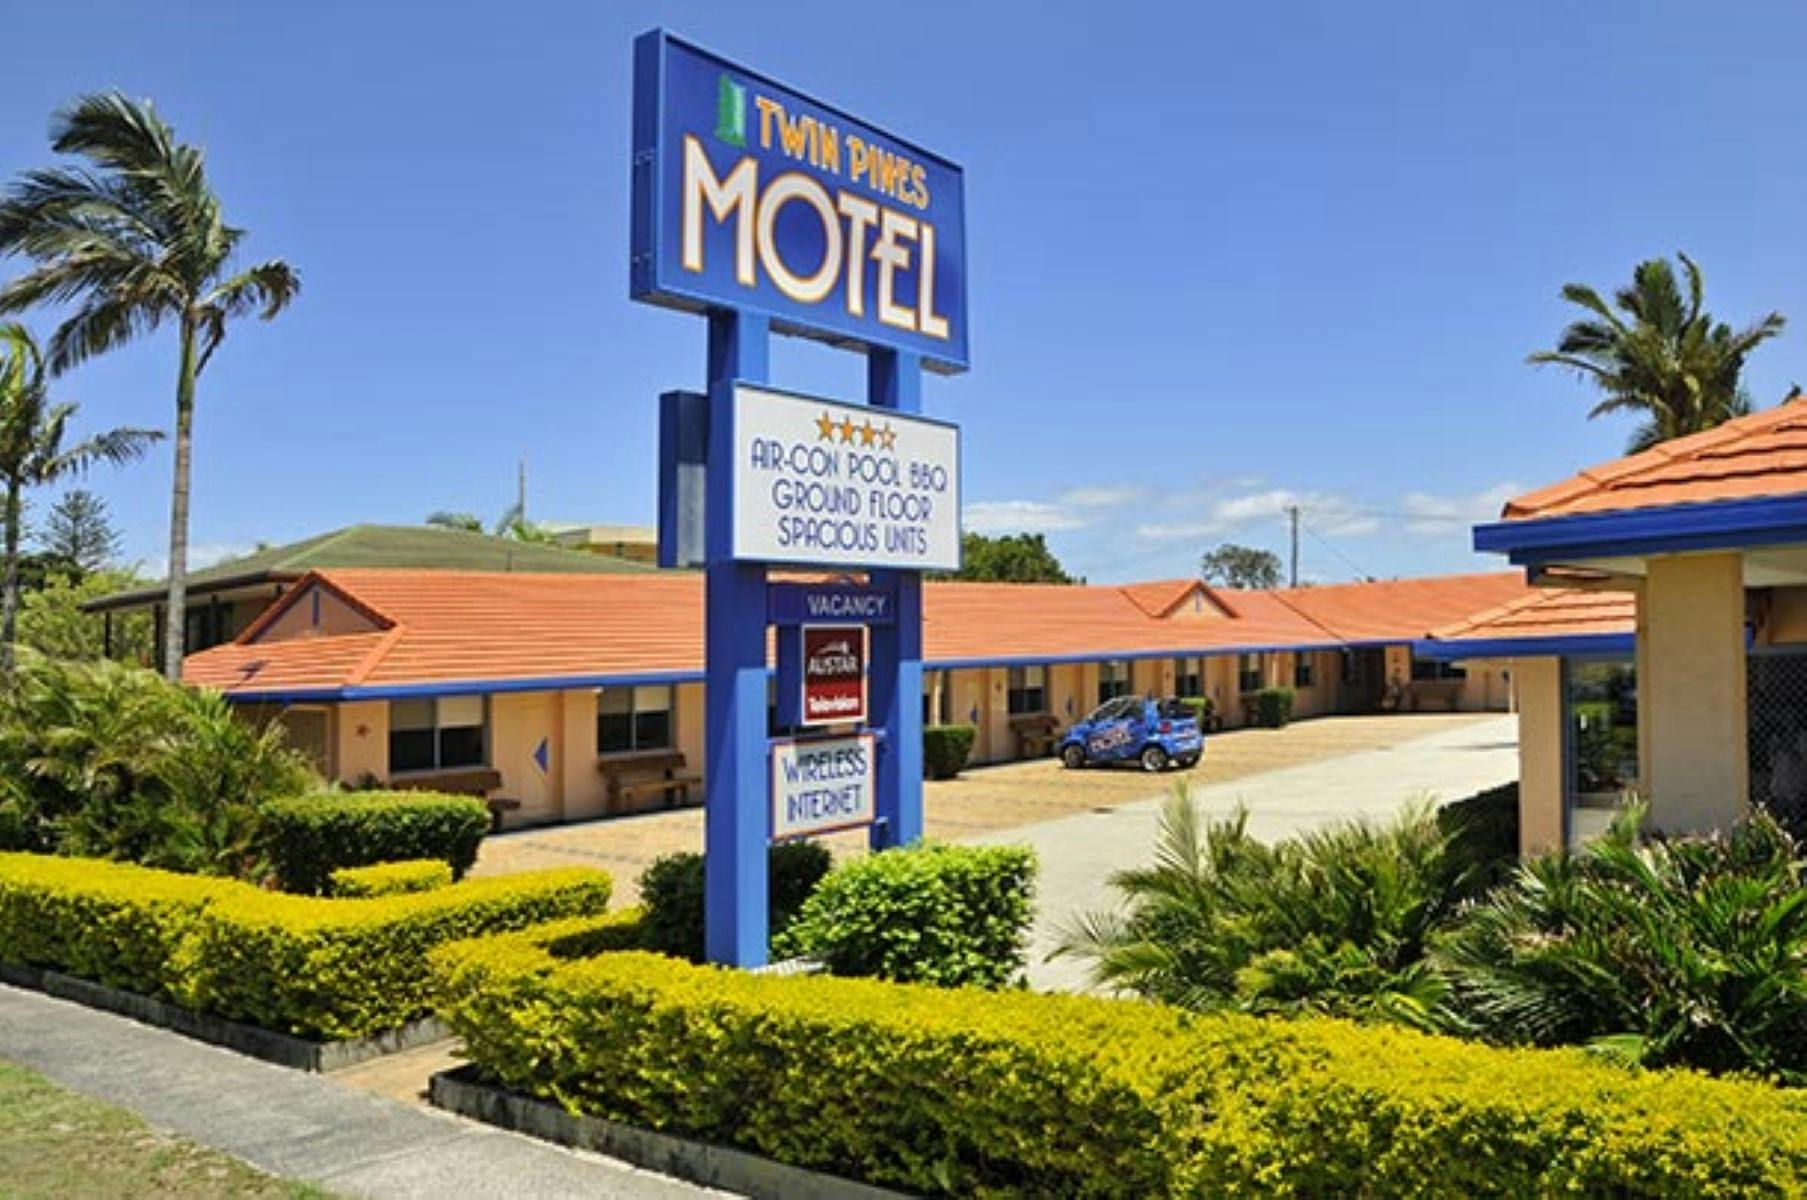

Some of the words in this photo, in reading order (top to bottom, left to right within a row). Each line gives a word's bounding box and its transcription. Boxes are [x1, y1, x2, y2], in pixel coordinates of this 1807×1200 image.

[756, 97, 839, 173] TWIN
[846, 135, 928, 209] PINES
[682, 135, 948, 339] MOTEL
[751, 438, 838, 477] AIR-CON
[849, 452, 901, 487] POOL
[909, 461, 947, 492] BBQ
[772, 478, 861, 516] GROUND
[869, 490, 933, 522] FLOOR
[778, 515, 878, 551] SPACIOUS
[885, 525, 927, 555] UNITS
[807, 595, 886, 617] VACANCY
[807, 655, 859, 675] AUSTAR
[782, 748, 867, 783] WIRELESS
[787, 784, 862, 823] INTERNET
